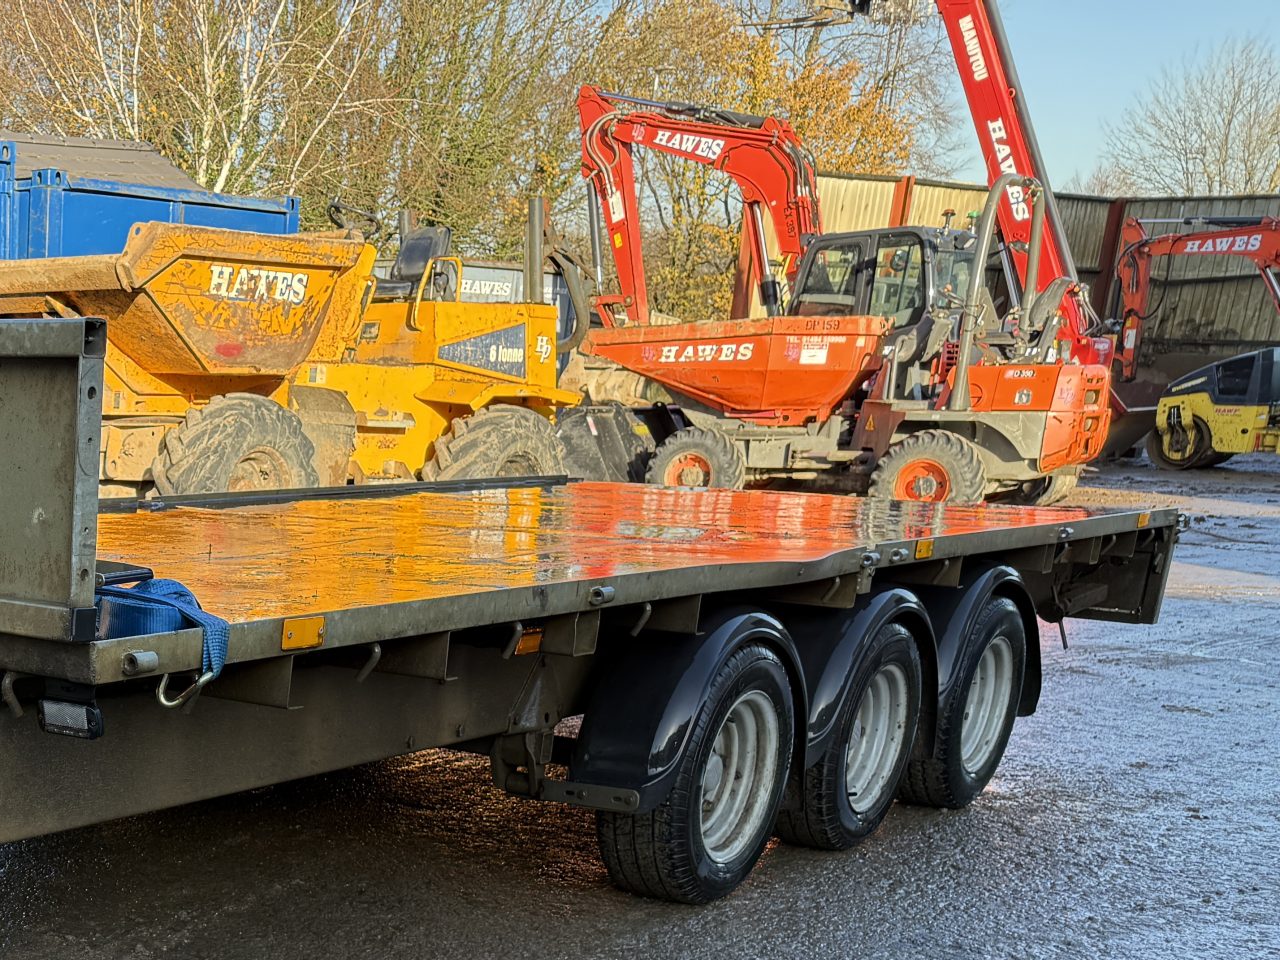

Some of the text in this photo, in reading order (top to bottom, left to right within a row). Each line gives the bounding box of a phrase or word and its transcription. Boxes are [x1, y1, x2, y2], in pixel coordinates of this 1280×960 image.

[959, 14, 989, 82] MANITOU
[653, 130, 725, 160] HAWES
[1183, 234, 1262, 253] HAWES
[461, 279, 512, 296] HAWES
[489, 344, 497, 362] 6
[658, 342, 755, 364] HAWES
